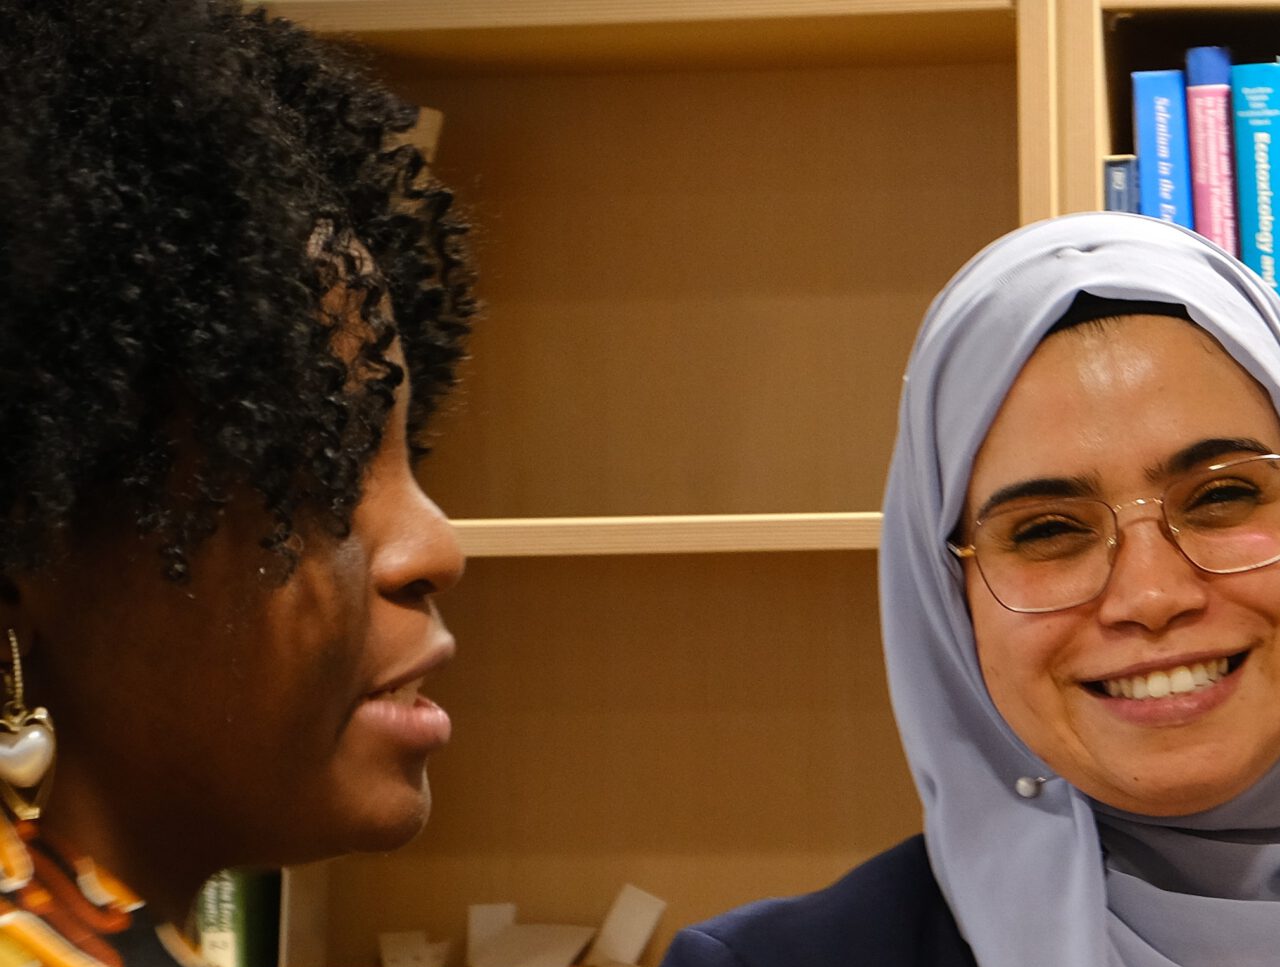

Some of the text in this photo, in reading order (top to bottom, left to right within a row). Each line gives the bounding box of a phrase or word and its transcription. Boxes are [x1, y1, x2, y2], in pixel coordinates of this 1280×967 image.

[1154, 97, 1171, 158] Selenium
[1158, 161, 1173, 174] in
[1159, 179, 1175, 199] the
[1254, 132, 1275, 254] Ecotoxicology
